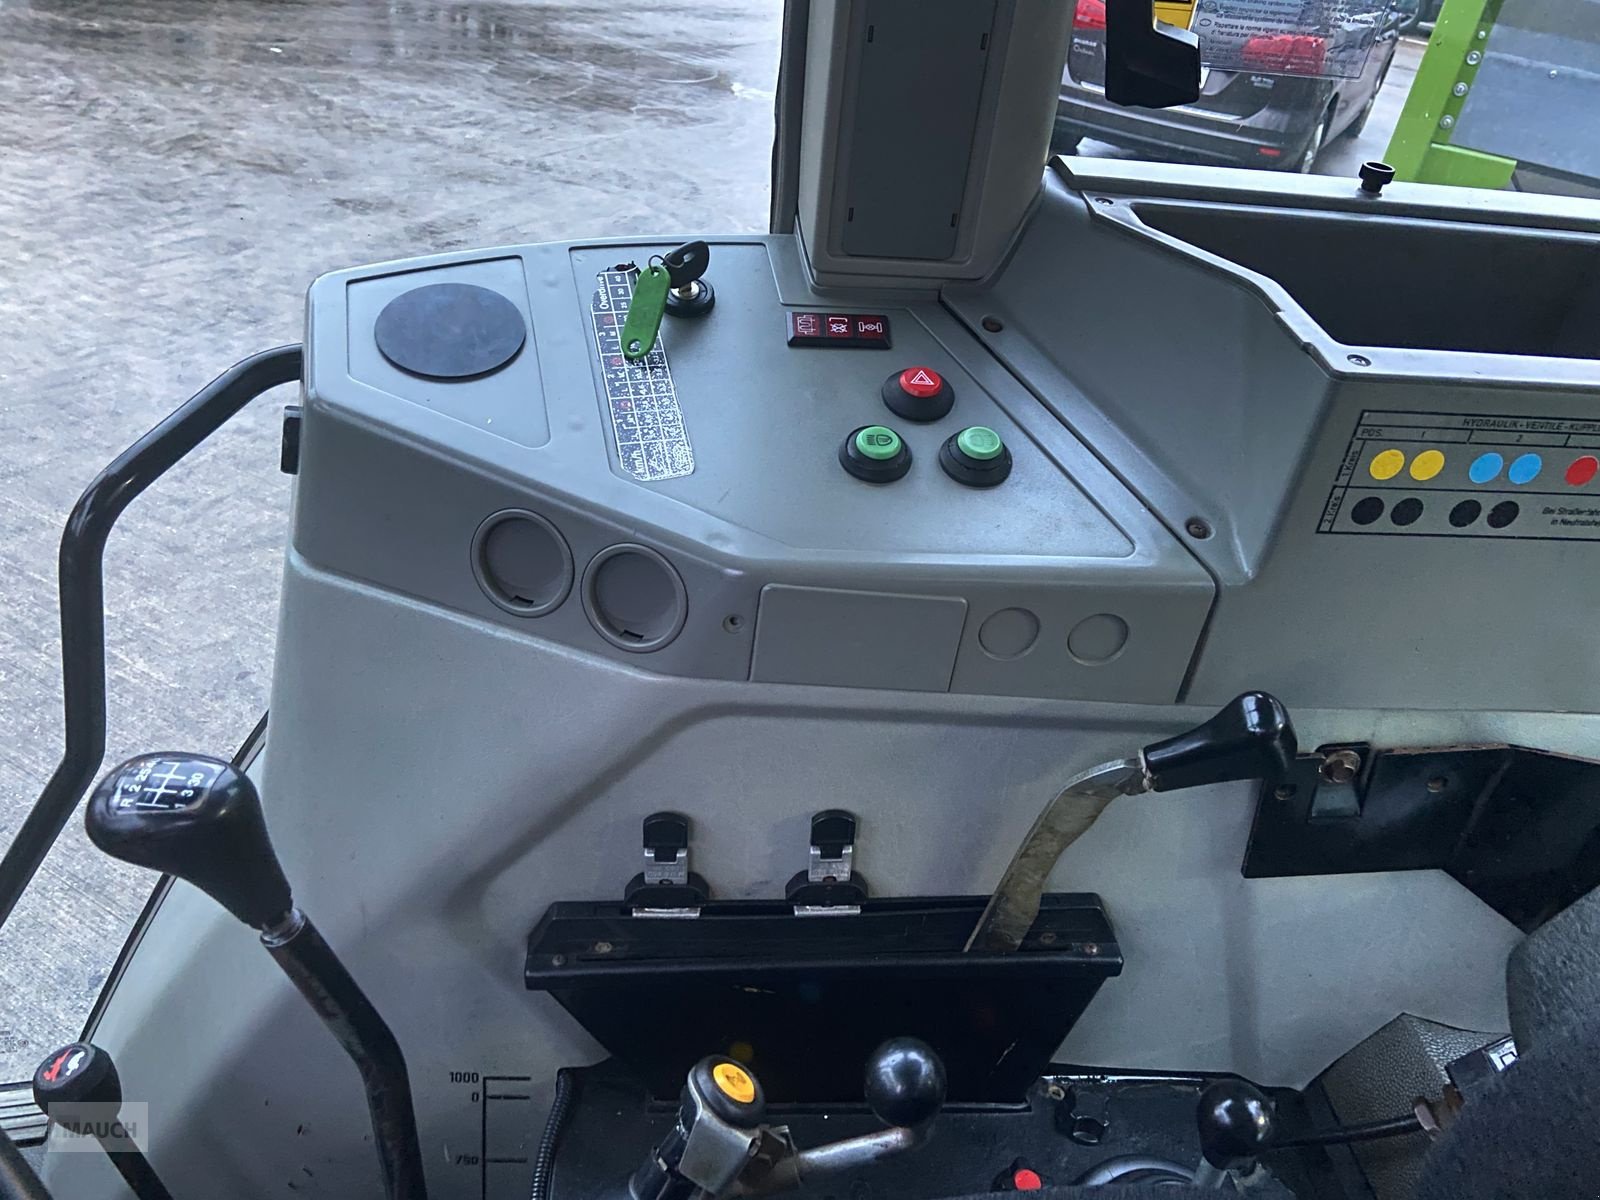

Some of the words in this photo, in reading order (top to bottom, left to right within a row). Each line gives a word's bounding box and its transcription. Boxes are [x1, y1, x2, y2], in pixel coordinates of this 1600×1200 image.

[598, 276, 609, 310] Overdrive
[134, 768, 152, 782] 25
[187, 772, 204, 787] 30
[128, 784, 141, 793] 2
[181, 789, 194, 797] 3
[120, 798, 134, 808] R
[449, 1071, 479, 1084] 1000
[471, 1092, 479, 1103] 0
[456, 1155, 479, 1166] 750
